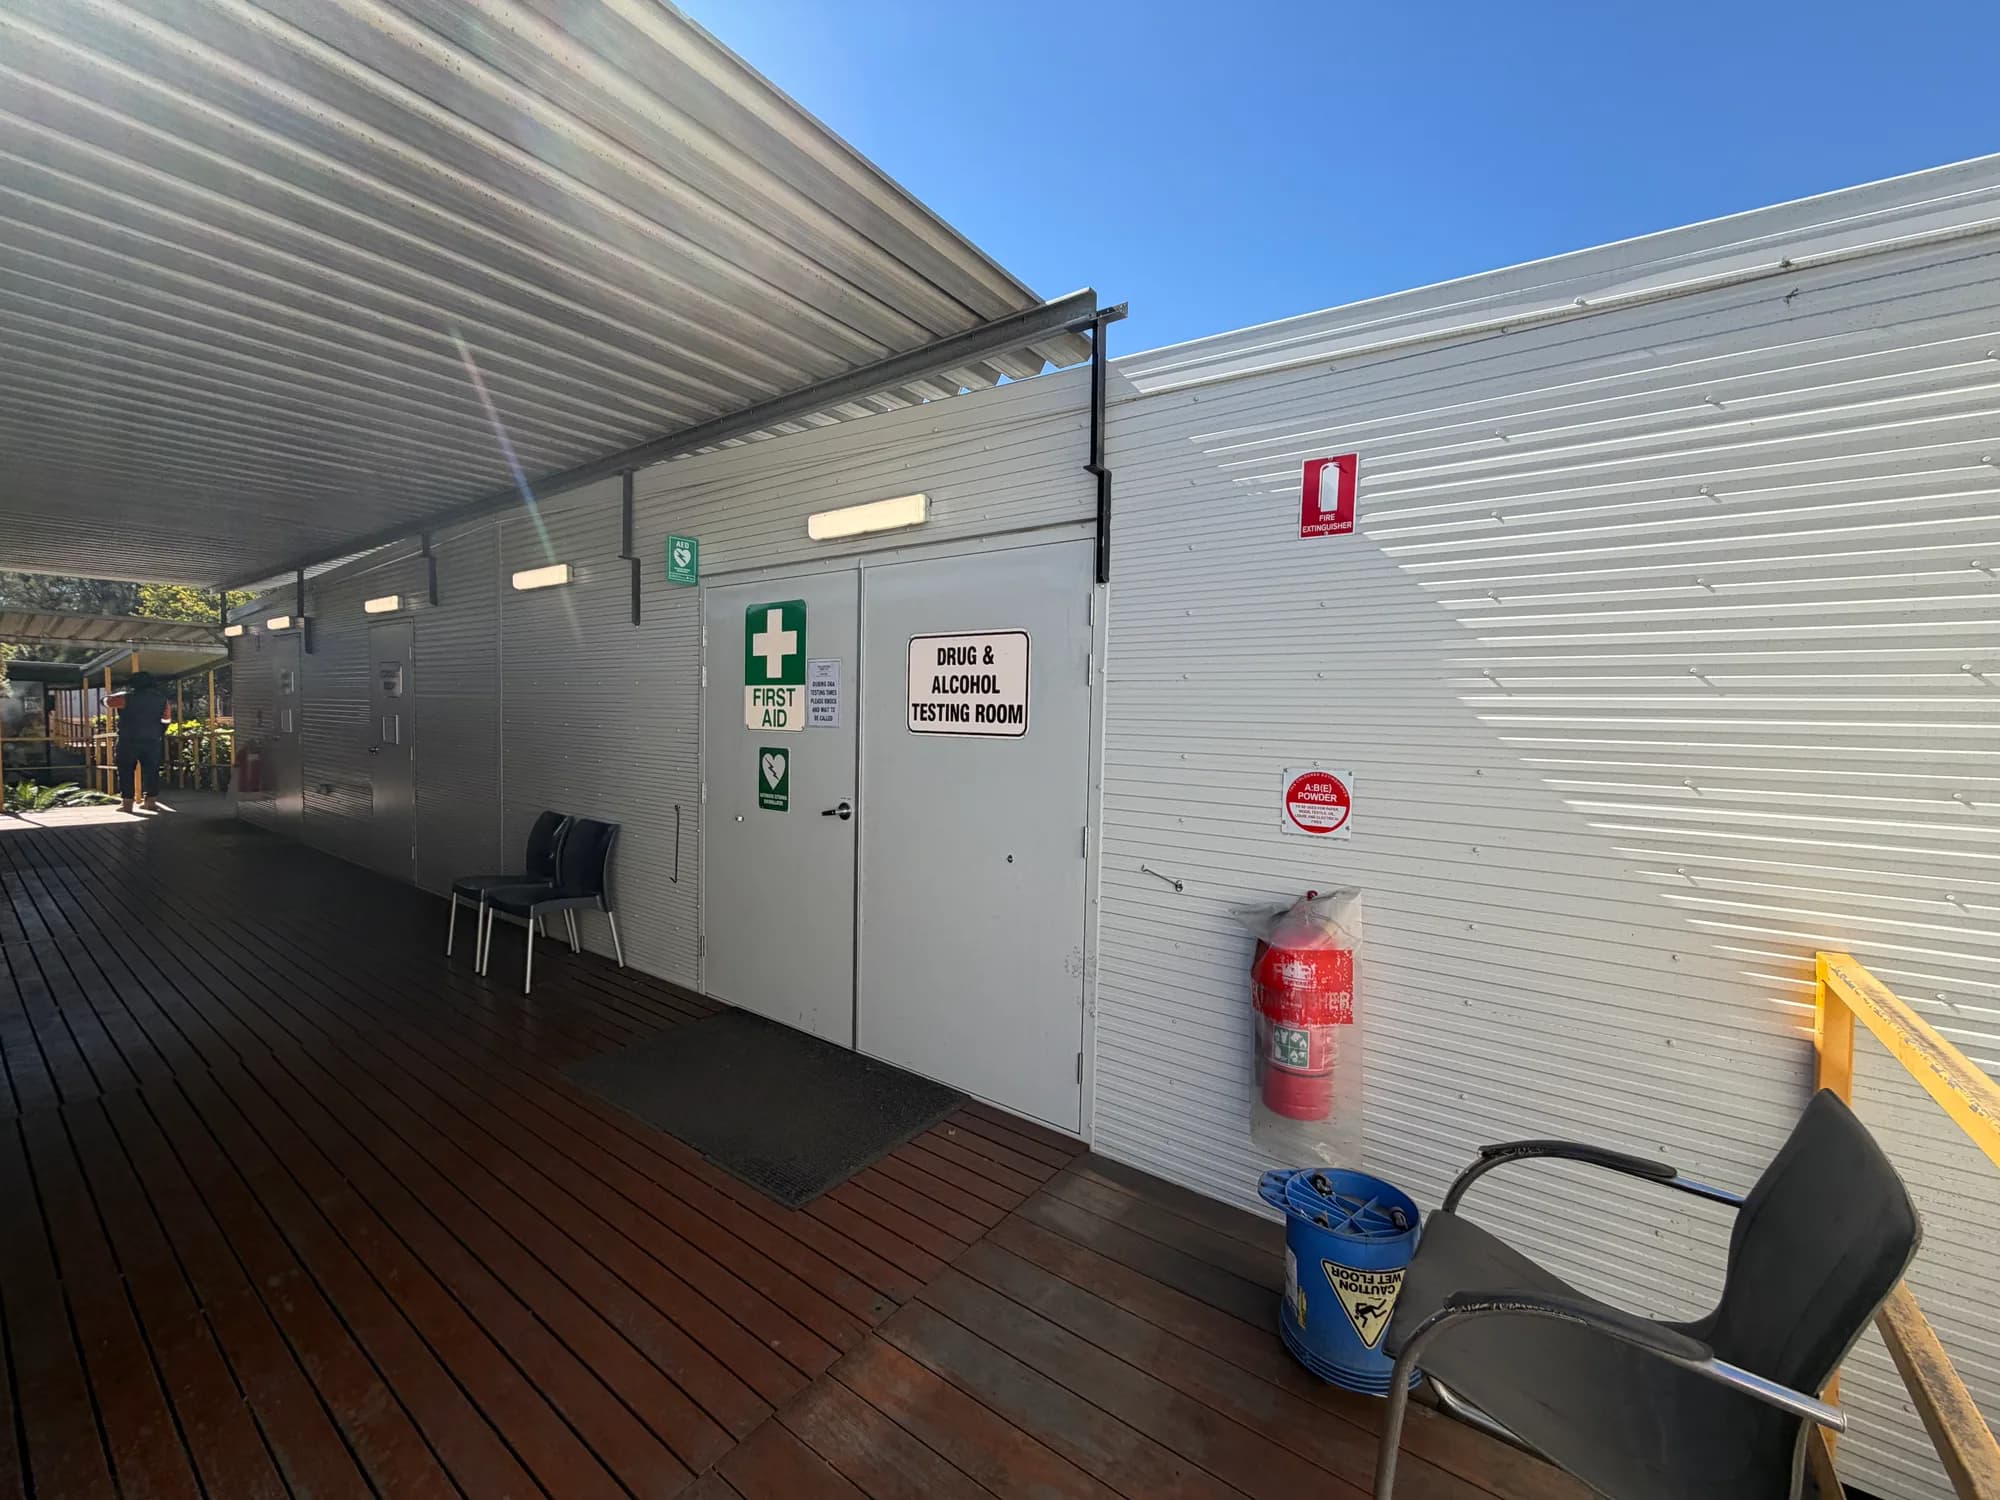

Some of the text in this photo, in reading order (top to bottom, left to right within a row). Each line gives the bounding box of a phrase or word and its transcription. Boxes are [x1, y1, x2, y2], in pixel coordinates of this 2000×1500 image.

[1303, 521, 1352, 533] EXTINGUISHER
[1319, 513, 1336, 522] FIRE
[676, 541, 690, 549] AED
[937, 645, 995, 666] DRUG &
[931, 674, 1001, 694] ALCOHOL
[753, 687, 796, 707] FIRST
[762, 708, 788, 728] AID
[912, 703, 1023, 724] TESTING ROOM
[1298, 792, 1338, 802] POWDER
[1331, 1266, 1402, 1285] WET FLOOR
[1339, 1280, 1396, 1295] CAUTION
